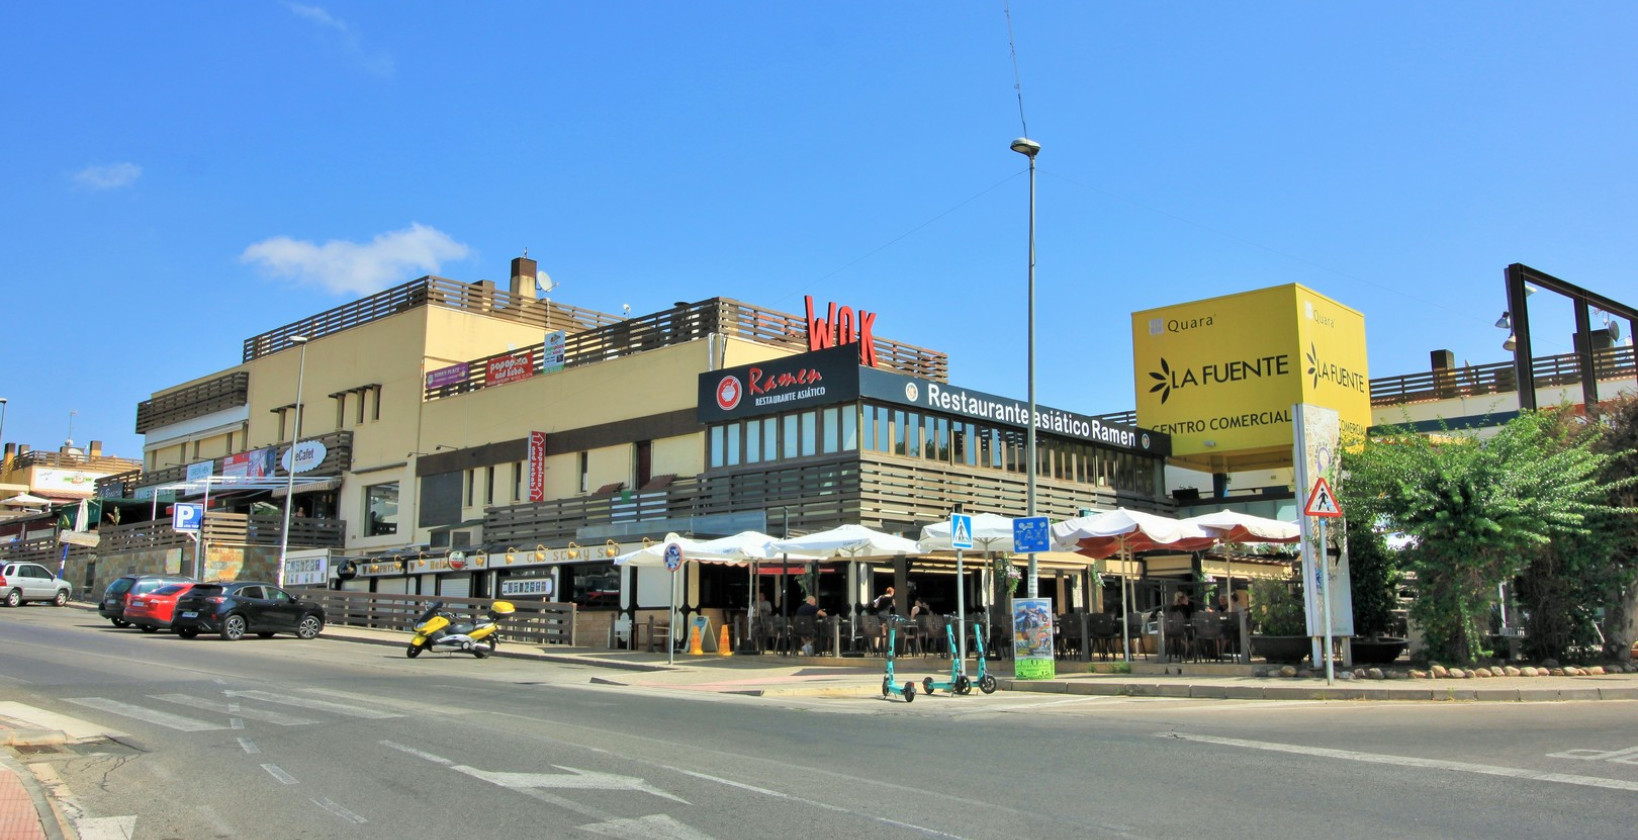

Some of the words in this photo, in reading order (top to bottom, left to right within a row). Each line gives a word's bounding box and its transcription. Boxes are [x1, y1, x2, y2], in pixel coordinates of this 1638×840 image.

[804, 295, 878, 367] WOK
[1167, 316, 1213, 333] Quara
[1313, 310, 1335, 328] Quara
[749, 367, 823, 396] Ramen
[1171, 368, 1198, 389] LA
[1202, 354, 1289, 384] FUENTE
[1317, 359, 1330, 381] LA
[1330, 364, 1365, 394] FUENTE
[755, 391, 796, 406] RESTAURANTE
[797, 386, 826, 400] ASIÁTICO
[928, 383, 1029, 425] Restaurante
[1034, 410, 1089, 437] asiático
[1092, 419, 1136, 447] Ramen
[1209, 410, 1292, 431] COMERCIAL
[176, 505, 194, 528] P
